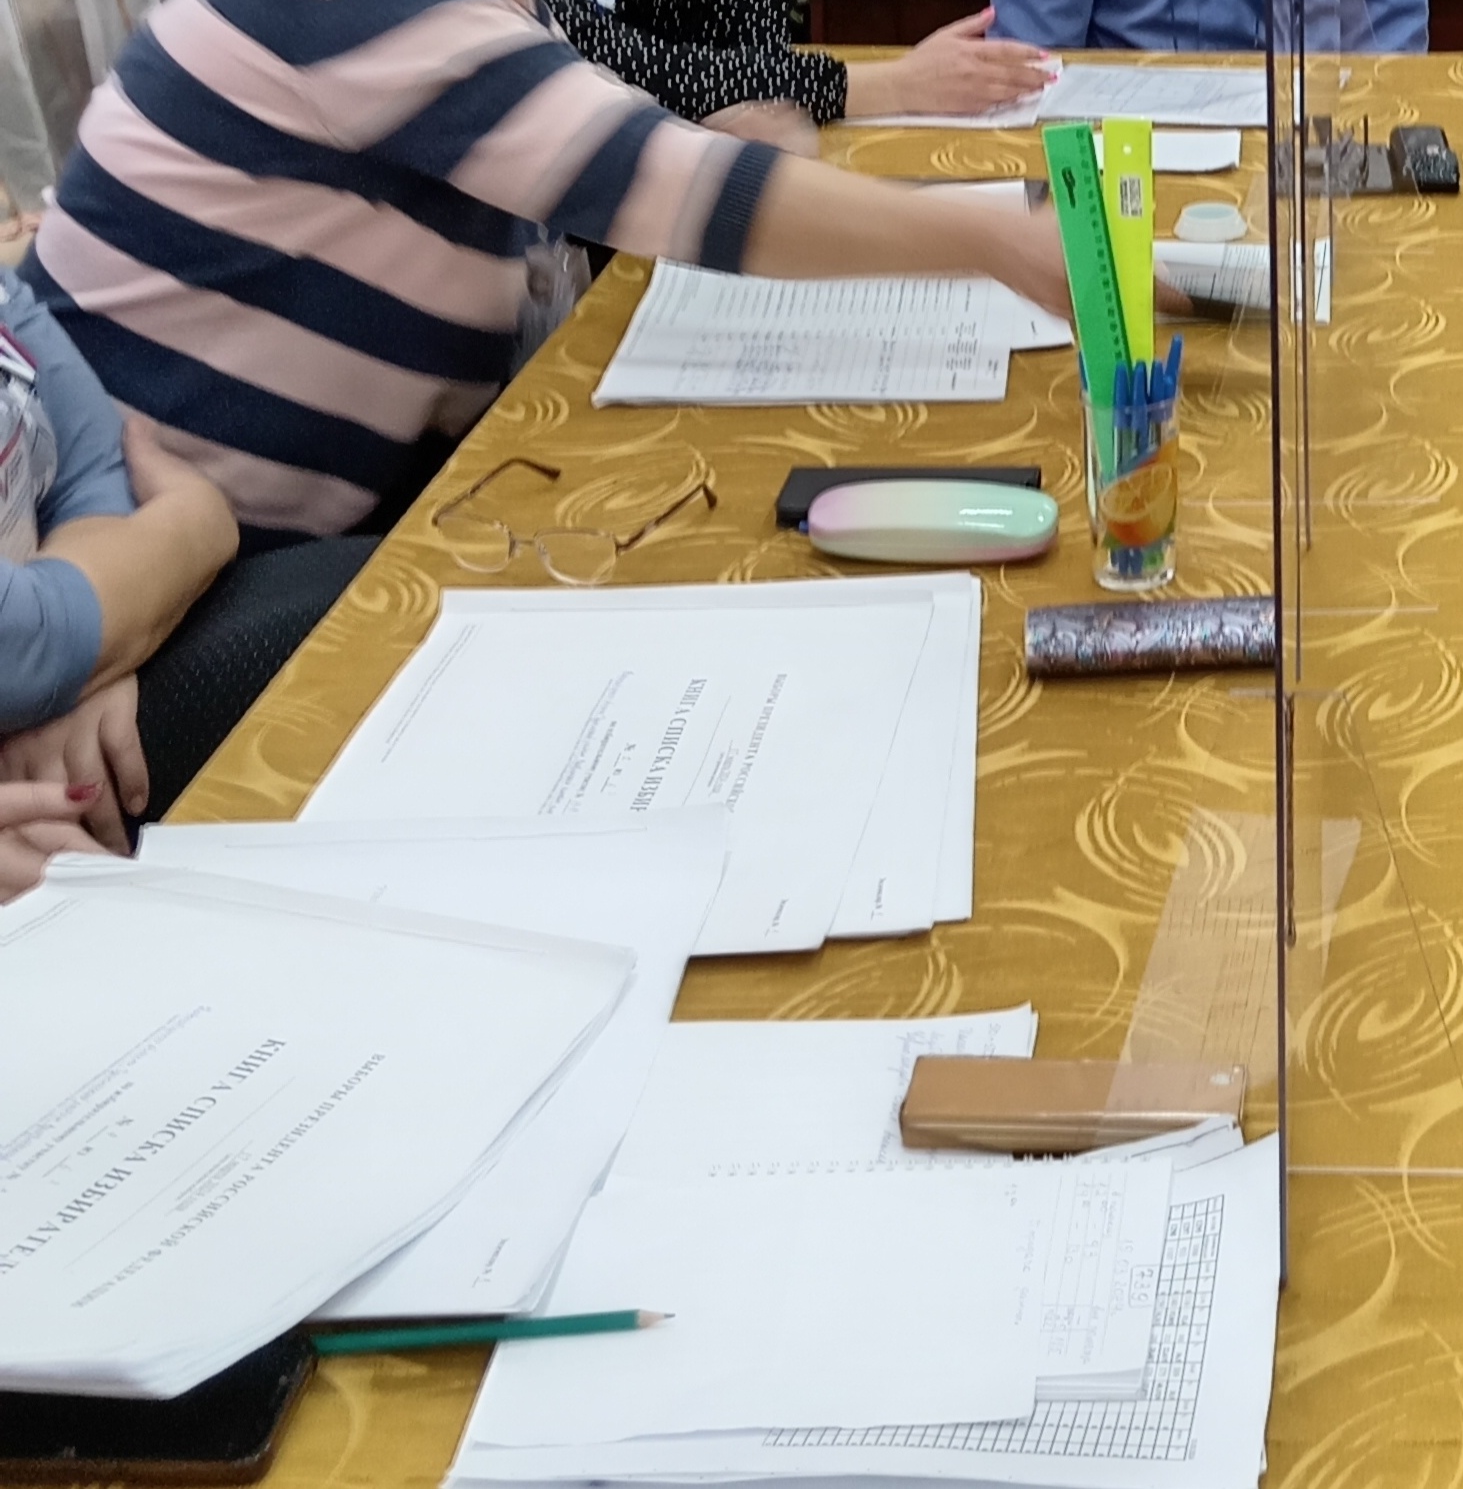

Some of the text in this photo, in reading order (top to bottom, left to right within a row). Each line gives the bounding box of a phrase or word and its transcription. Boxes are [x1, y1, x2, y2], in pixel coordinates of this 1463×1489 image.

[674, 679, 707, 715] КНИГА
[649, 718, 687, 779] СПИСКА
[330, 1054, 385, 1101] ВЫБОРЫ
[0, 1039, 286, 1274] КНИГА СПИСКА ИЗБИРАТЕЛ
[251, 1102, 335, 1170] ПРЕЗИДЕНТА
[160, 1174, 255, 1247] РОССИЙСКОЙ
